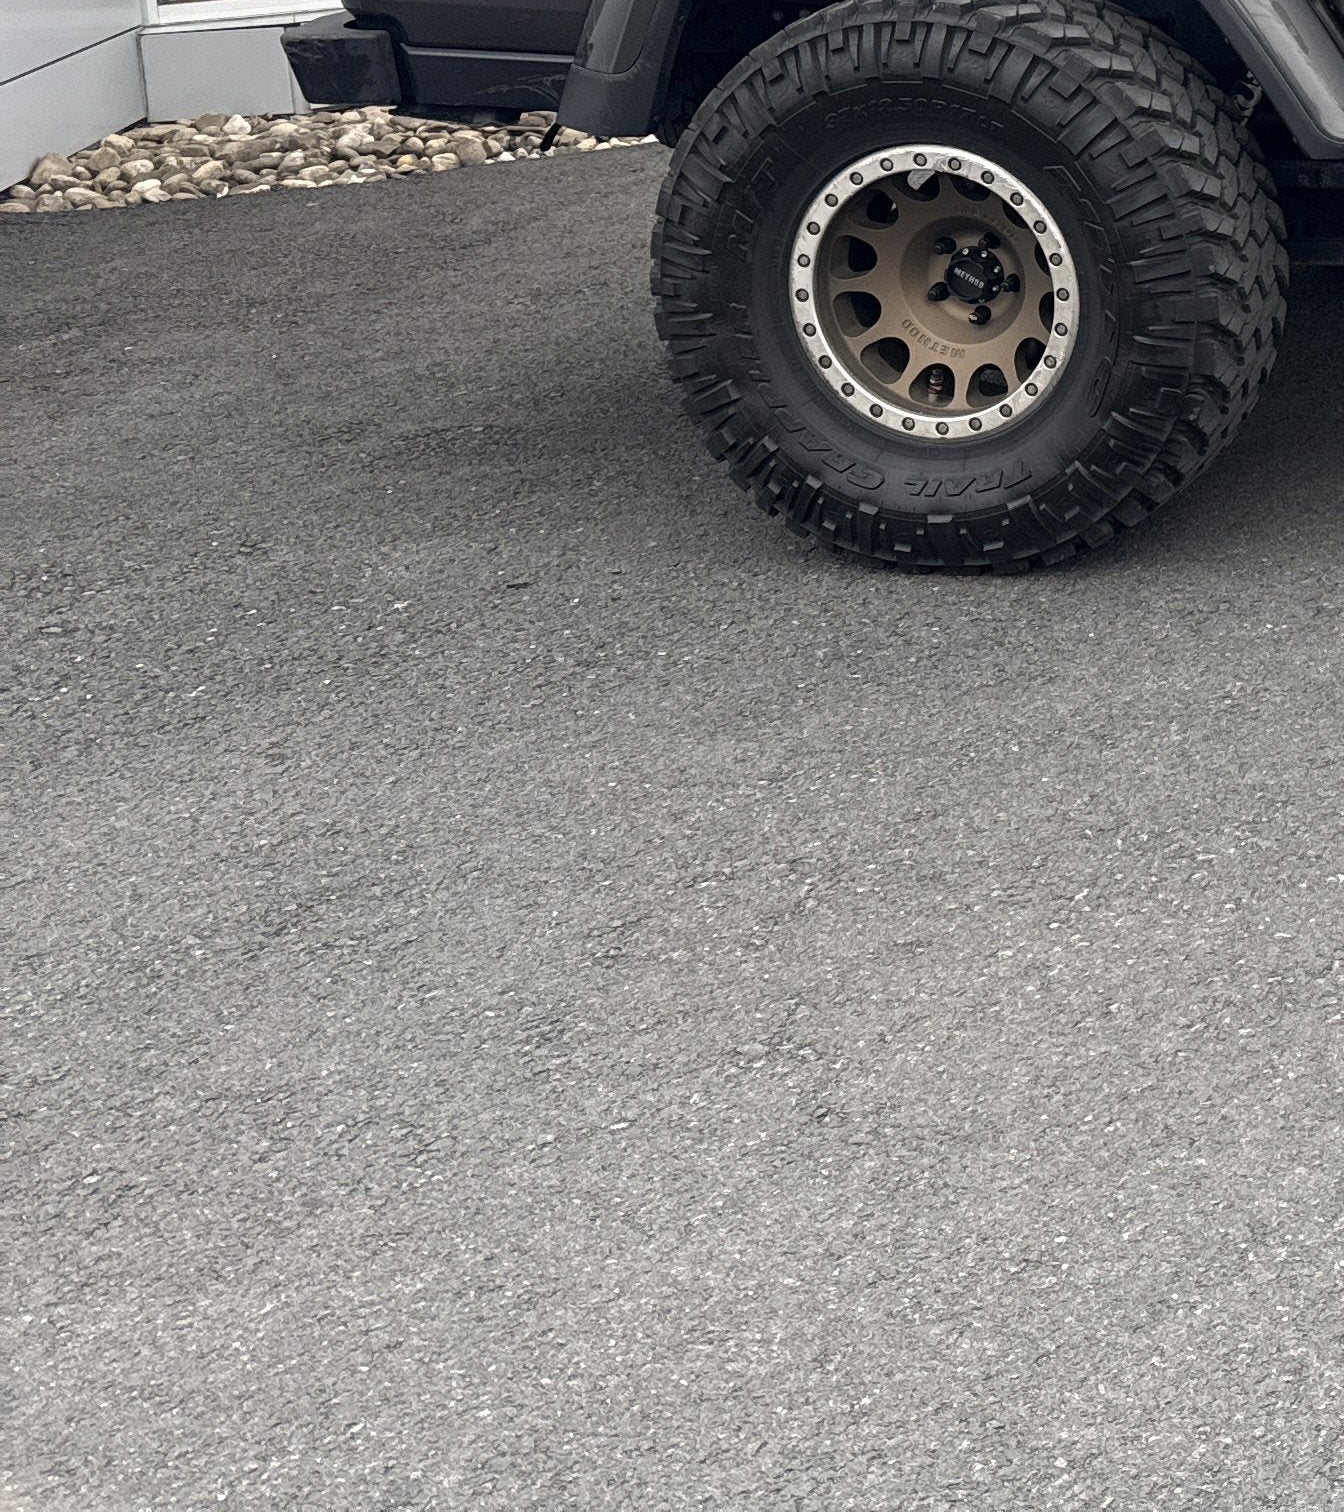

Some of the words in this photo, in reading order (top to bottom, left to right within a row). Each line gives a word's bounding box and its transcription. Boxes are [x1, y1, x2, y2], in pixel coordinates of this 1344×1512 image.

[953, 267, 986, 291] METHOD
[901, 318, 967, 361] METHOD
[904, 458, 1035, 499] TRAIL
